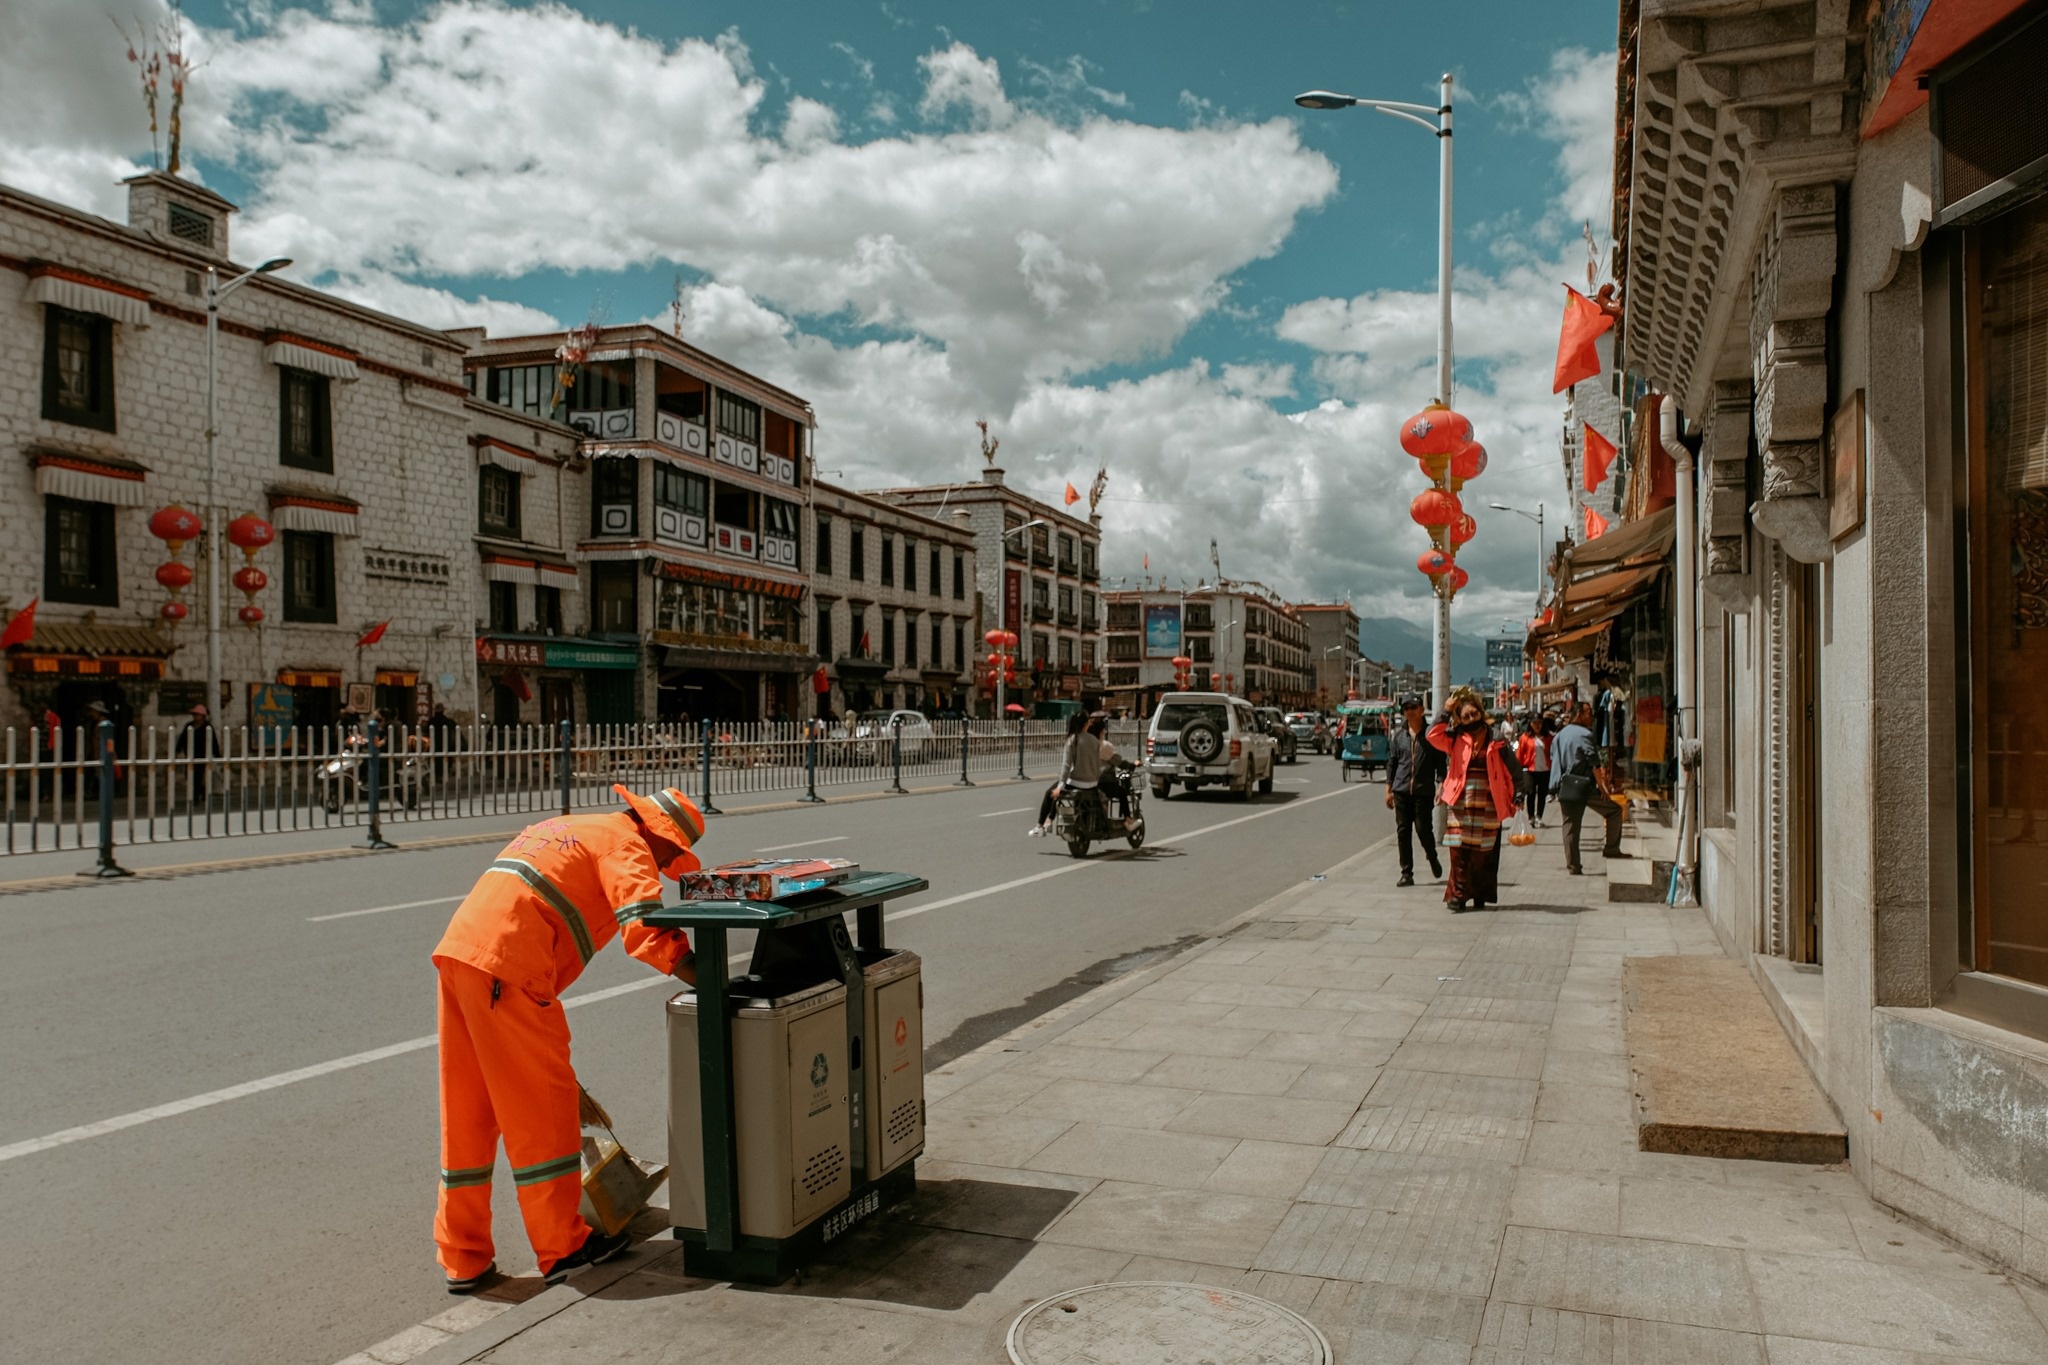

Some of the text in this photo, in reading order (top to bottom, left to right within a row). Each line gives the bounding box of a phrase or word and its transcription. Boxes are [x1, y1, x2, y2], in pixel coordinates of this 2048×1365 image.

[822, 1189, 880, 1244] 城关区环保局宣
